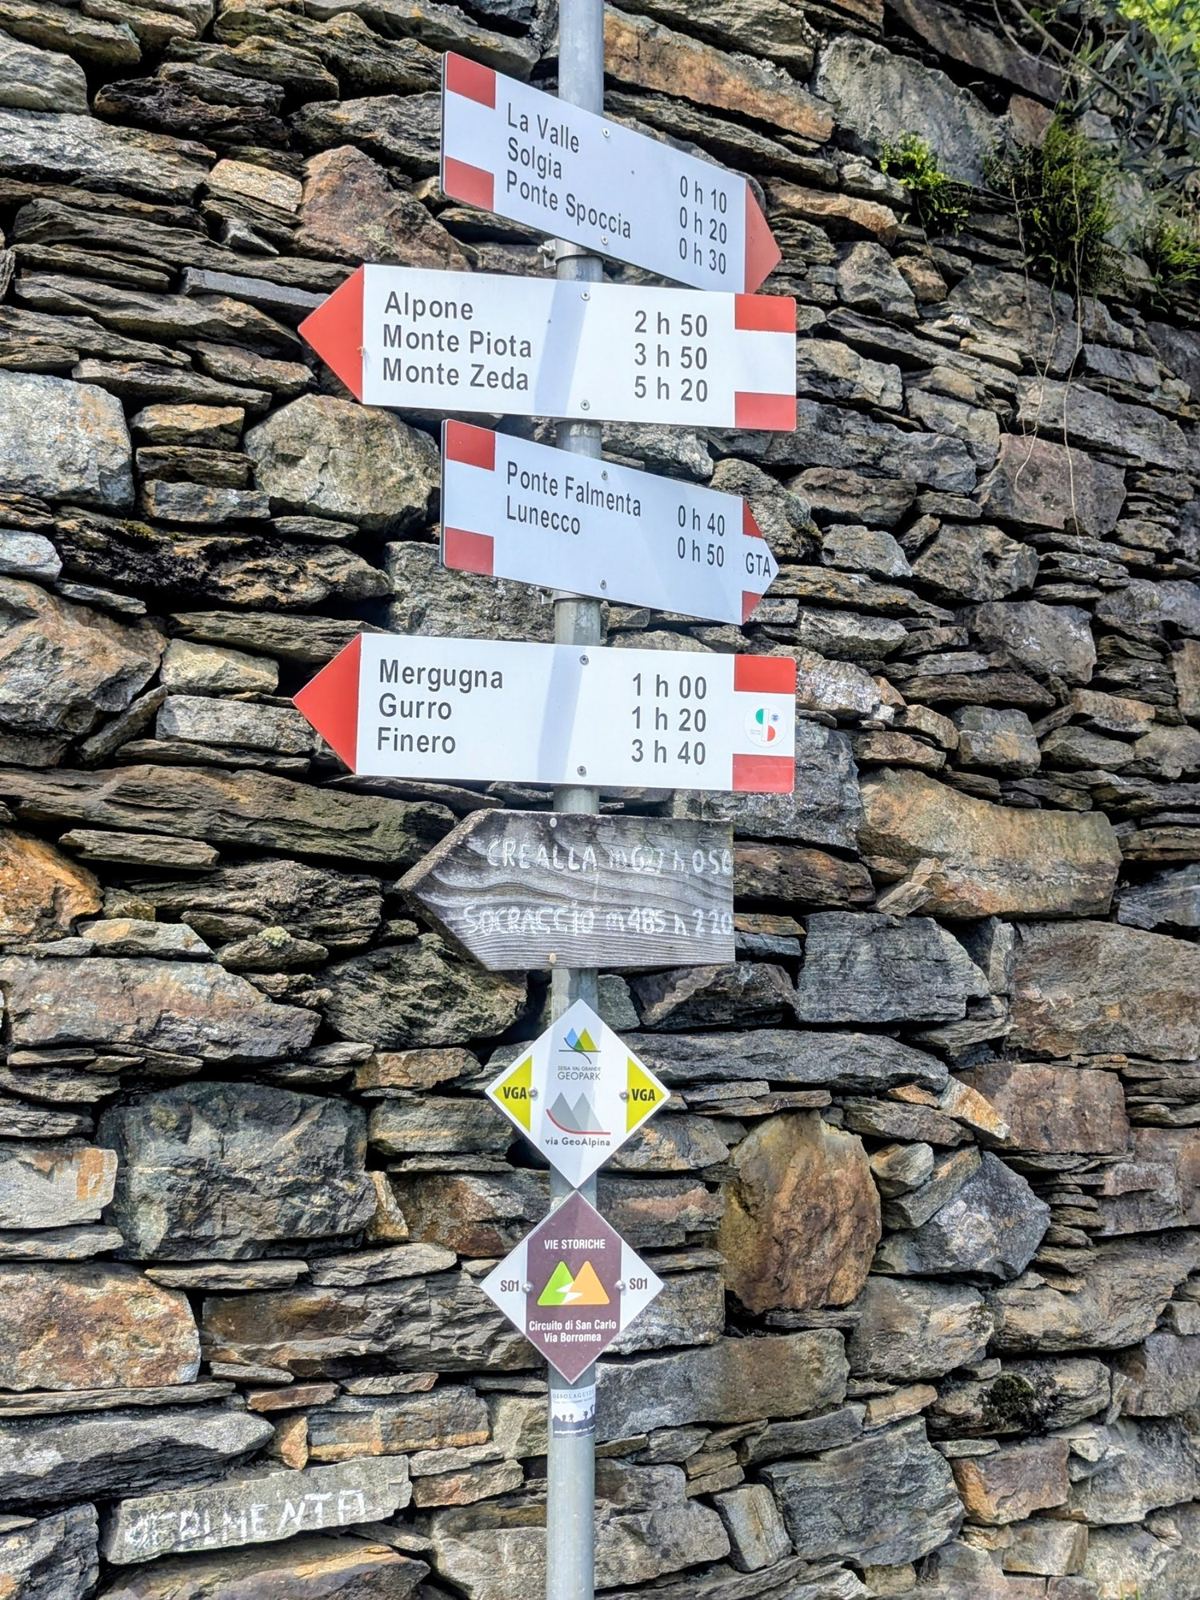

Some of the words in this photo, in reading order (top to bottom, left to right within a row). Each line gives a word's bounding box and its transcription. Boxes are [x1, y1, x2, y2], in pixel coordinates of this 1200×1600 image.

[507, 102, 529, 133] La
[536, 114, 579, 154] Valle
[506, 135, 562, 181] Solgia
[506, 167, 559, 211] Ponte
[565, 193, 632, 240] Spoccia
[679, 175, 688, 198] 0
[694, 180, 703, 205] h
[710, 188, 727, 214] 10
[679, 206, 688, 229] 0
[694, 211, 703, 236] h
[709, 218, 727, 245] 20
[679, 237, 688, 260] 0
[693, 242, 702, 266] h
[708, 248, 727, 275] 30
[384, 291, 473, 322] Alpone
[634, 310, 647, 333] 2
[657, 311, 670, 335] h
[680, 313, 708, 338] 50
[383, 323, 460, 353] Monte
[470, 330, 531, 358] Piota
[634, 342, 647, 366] 3
[657, 344, 670, 368] h
[680, 346, 707, 370] 50
[383, 357, 459, 386] Monte
[469, 363, 528, 391] Zeda
[634, 375, 647, 399] 5
[657, 376, 670, 400] h
[680, 378, 708, 402] 20
[507, 460, 559, 497] Ponte
[565, 475, 642, 518] Falmenta
[506, 494, 582, 537] Lunecco
[677, 504, 687, 528] 0
[692, 507, 701, 532] h
[706, 512, 725, 537] 40
[677, 536, 686, 560] 0
[691, 539, 701, 563] h
[706, 543, 725, 568] 50
[745, 551, 773, 578] GTA
[379, 658, 503, 694] Mergugna
[632, 672, 641, 696] 1
[656, 674, 669, 698] h
[679, 675, 707, 700] 00
[379, 692, 452, 720] Gurro
[632, 706, 641, 729] 1
[655, 706, 668, 731] h
[678, 708, 707, 733] 20
[377, 726, 456, 754] Finero
[631, 738, 644, 763] 3
[654, 739, 667, 763] h
[677, 741, 706, 766] 40
[486, 835, 599, 873] CREALLA
[557, 1071, 600, 1081] GEOPARK
[503, 1086, 528, 1100] VGA
[631, 1088, 656, 1101] VGA
[545, 1138, 558, 1146] via
[561, 1136, 611, 1148] GeoAlpina
[544, 1239, 558, 1250] VIE
[561, 1238, 606, 1250] STORICHE
[529, 1320, 563, 1332] Circuito
[565, 1320, 574, 1331] di
[575, 1319, 592, 1331] San
[594, 1319, 617, 1331] Carlo
[544, 1332, 559, 1343] Via
[560, 1331, 602, 1343] Borromea
